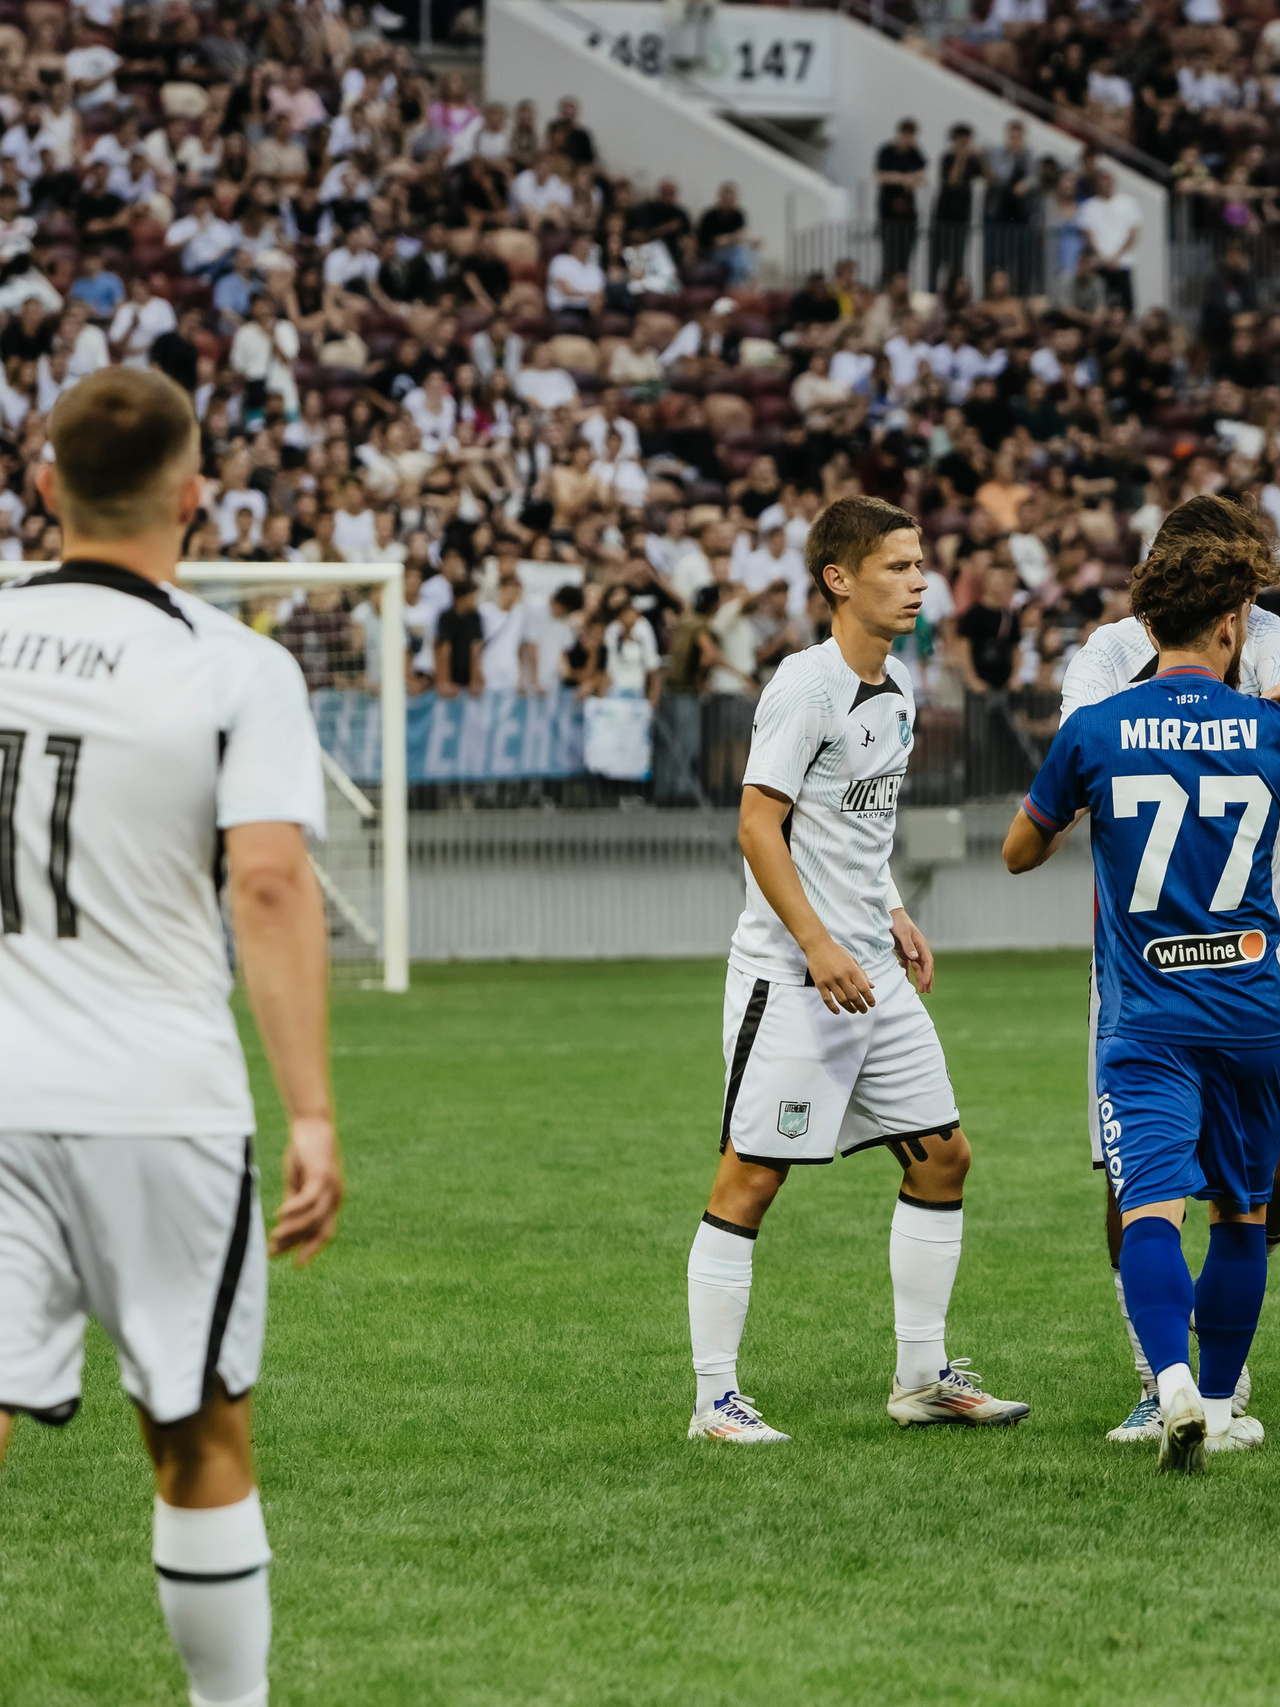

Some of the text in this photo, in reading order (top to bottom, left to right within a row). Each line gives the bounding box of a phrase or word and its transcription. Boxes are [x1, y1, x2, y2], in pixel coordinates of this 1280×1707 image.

[588, 32, 663, 77] 48
[736, 40, 814, 81] 147
[1176, 694, 1200, 705] 1937
[1120, 717, 1258, 751] MIRZOEV
[841, 776, 905, 812] LITENER
[1112, 774, 1273, 913] 77
[1155, 942, 1237, 965] Winline
